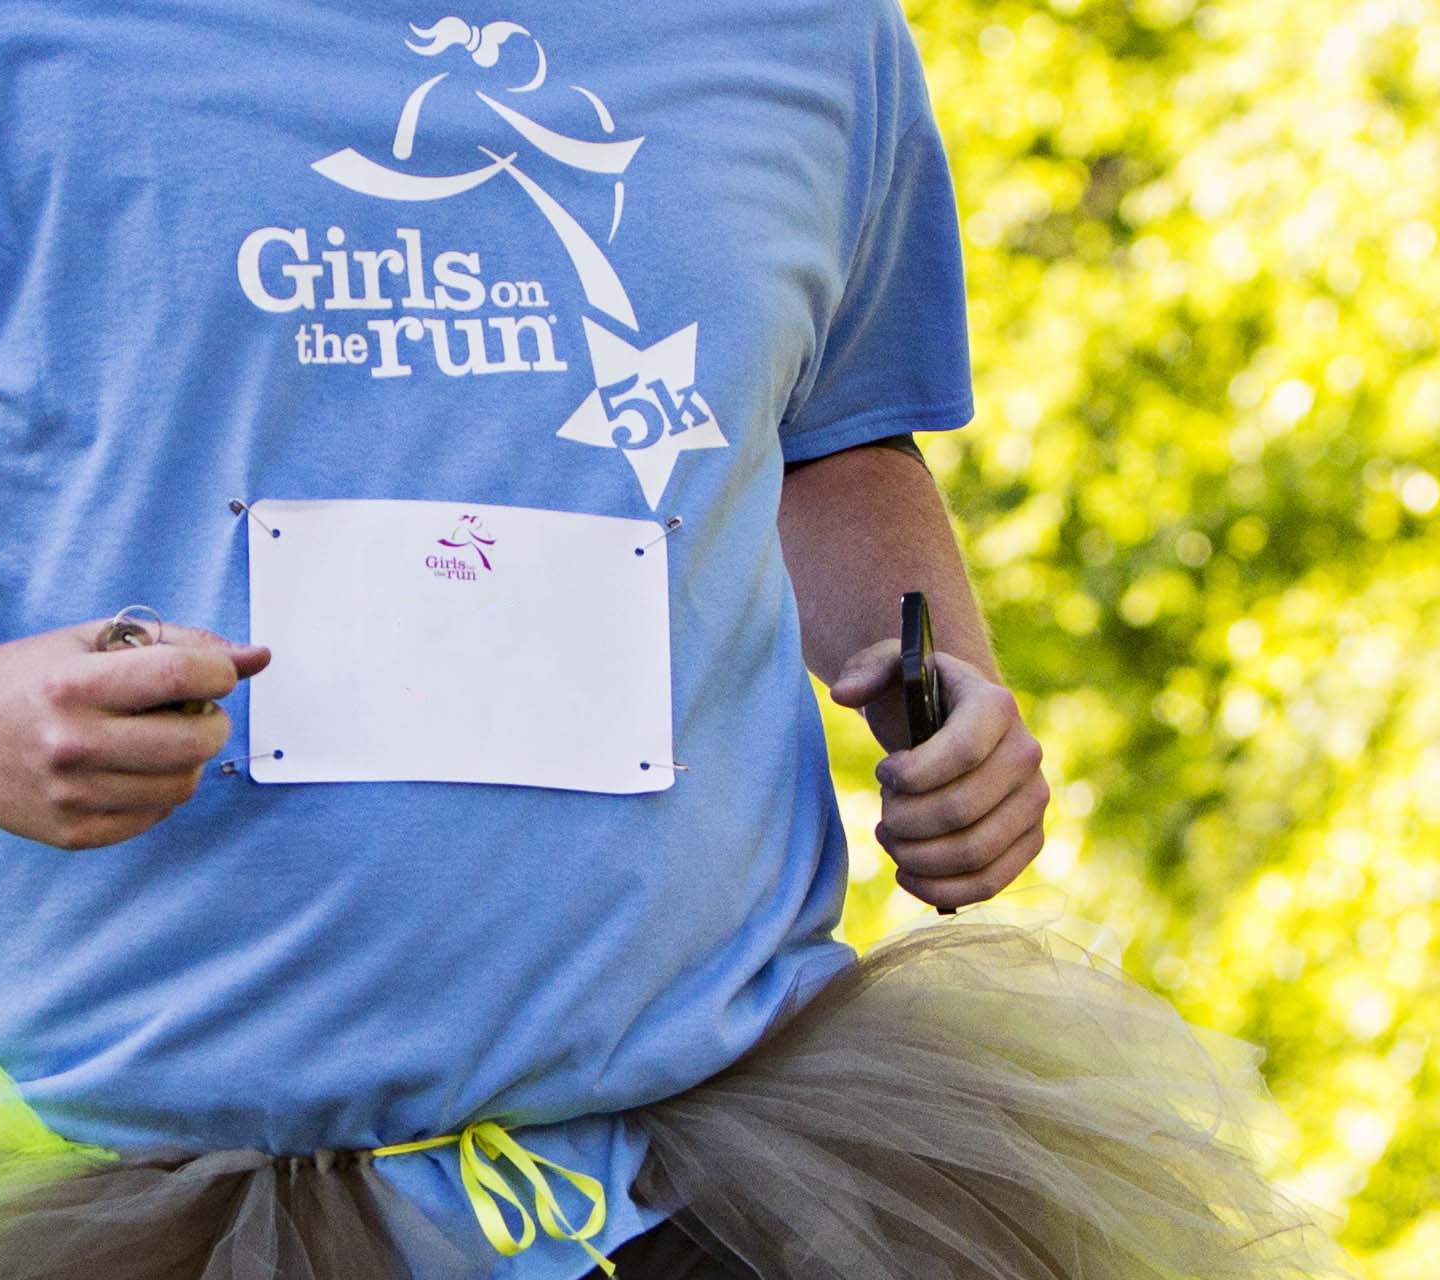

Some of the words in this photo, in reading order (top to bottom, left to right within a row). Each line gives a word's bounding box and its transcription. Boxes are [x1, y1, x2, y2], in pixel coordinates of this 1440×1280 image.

[237, 226, 486, 312] Girls
[490, 280, 549, 308] on
[295, 324, 368, 365] the
[368, 316, 568, 378] run
[598, 373, 710, 450] 5k
[425, 555, 466, 569] Girls
[447, 570, 478, 581] run
